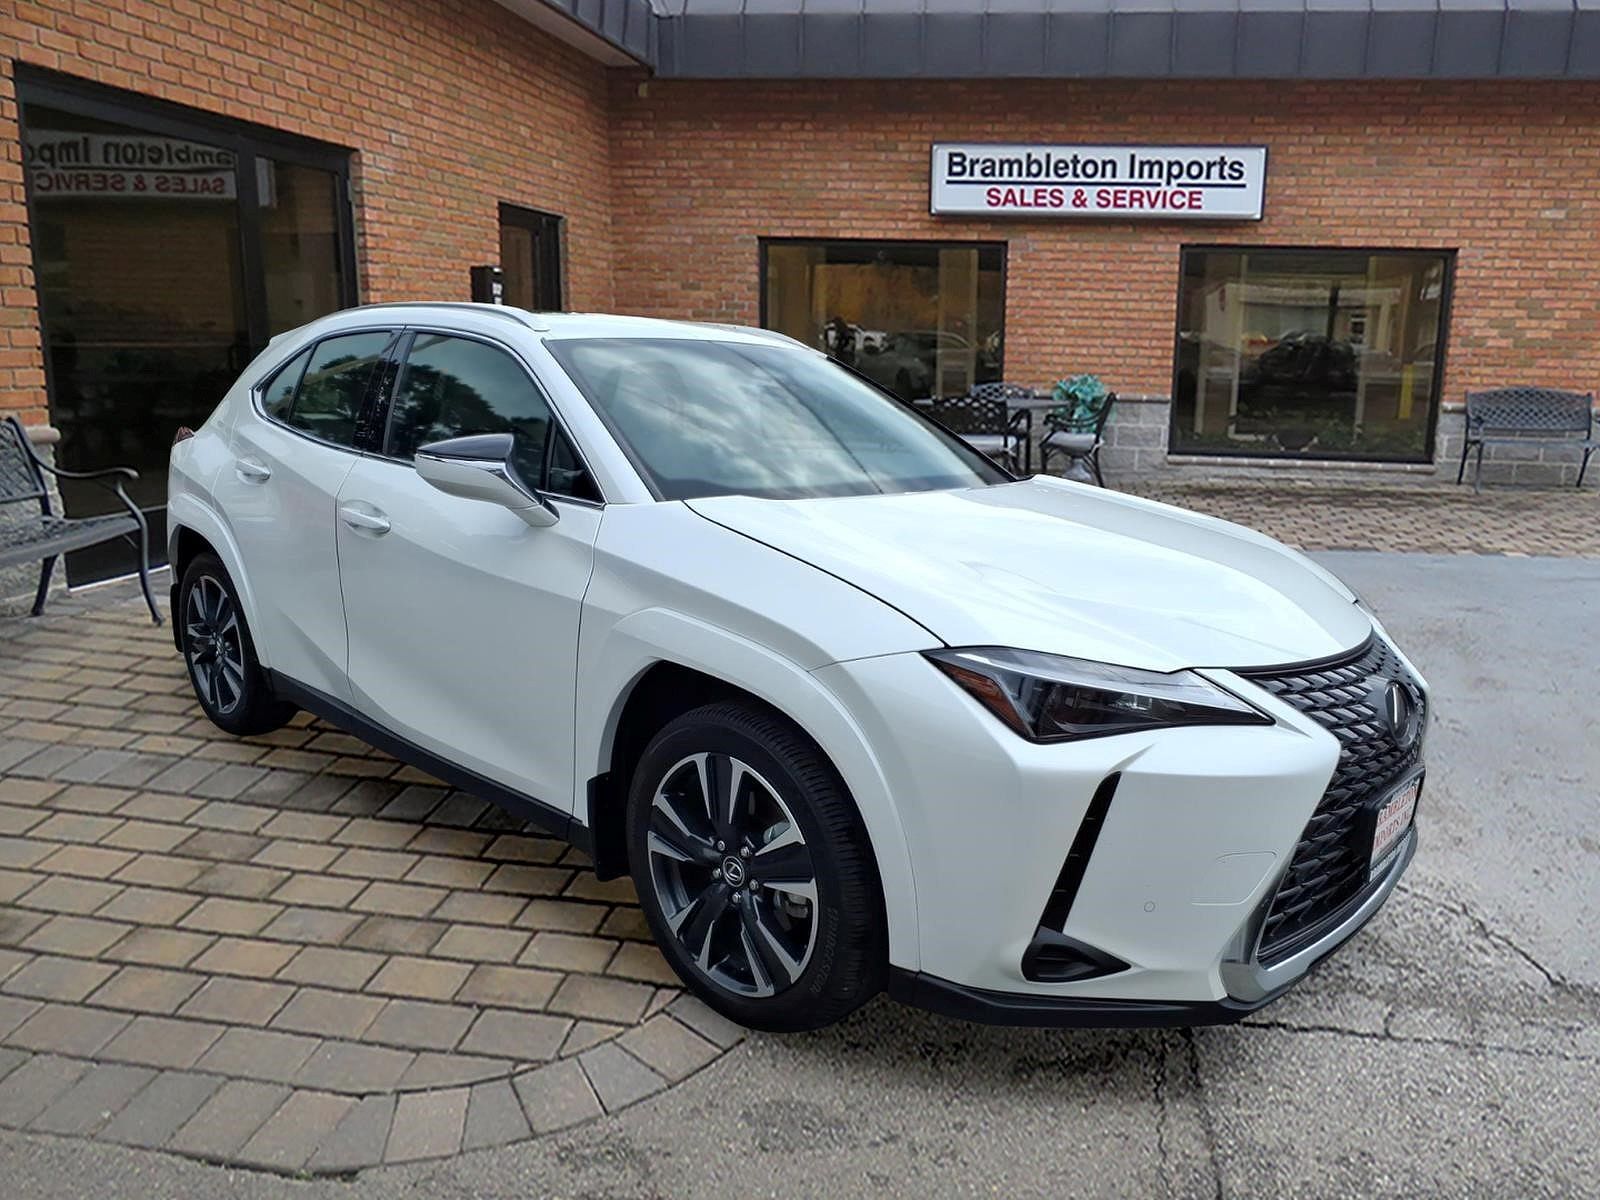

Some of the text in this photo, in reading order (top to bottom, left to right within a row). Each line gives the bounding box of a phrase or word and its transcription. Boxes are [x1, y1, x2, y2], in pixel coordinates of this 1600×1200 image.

[947, 152, 1245, 186] Brambleton Imports
[986, 187, 1203, 210] SALES & SERVICE
